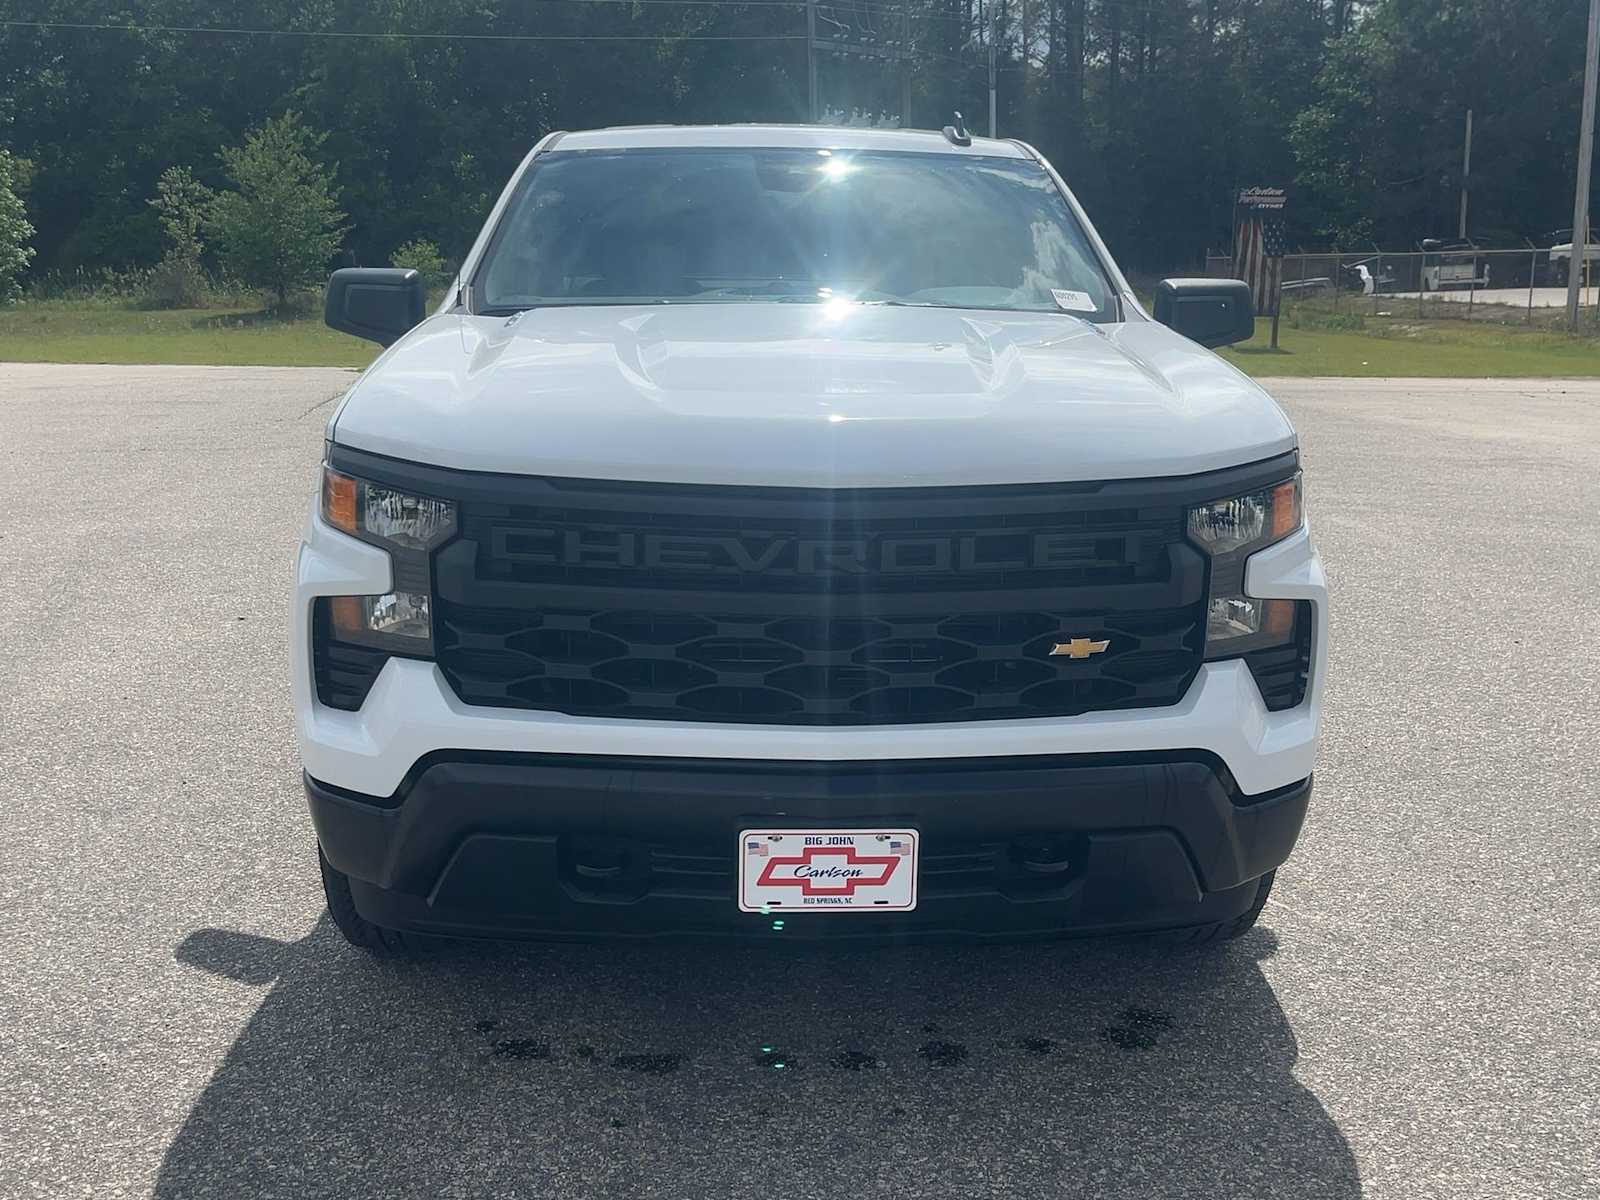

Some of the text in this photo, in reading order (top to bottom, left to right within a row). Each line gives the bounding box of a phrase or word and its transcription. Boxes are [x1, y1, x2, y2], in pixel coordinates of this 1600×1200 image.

[489, 525, 1158, 573] CHEVROLET
[804, 836, 854, 845] BIG JOHN
[793, 865, 863, 878] Carlson
